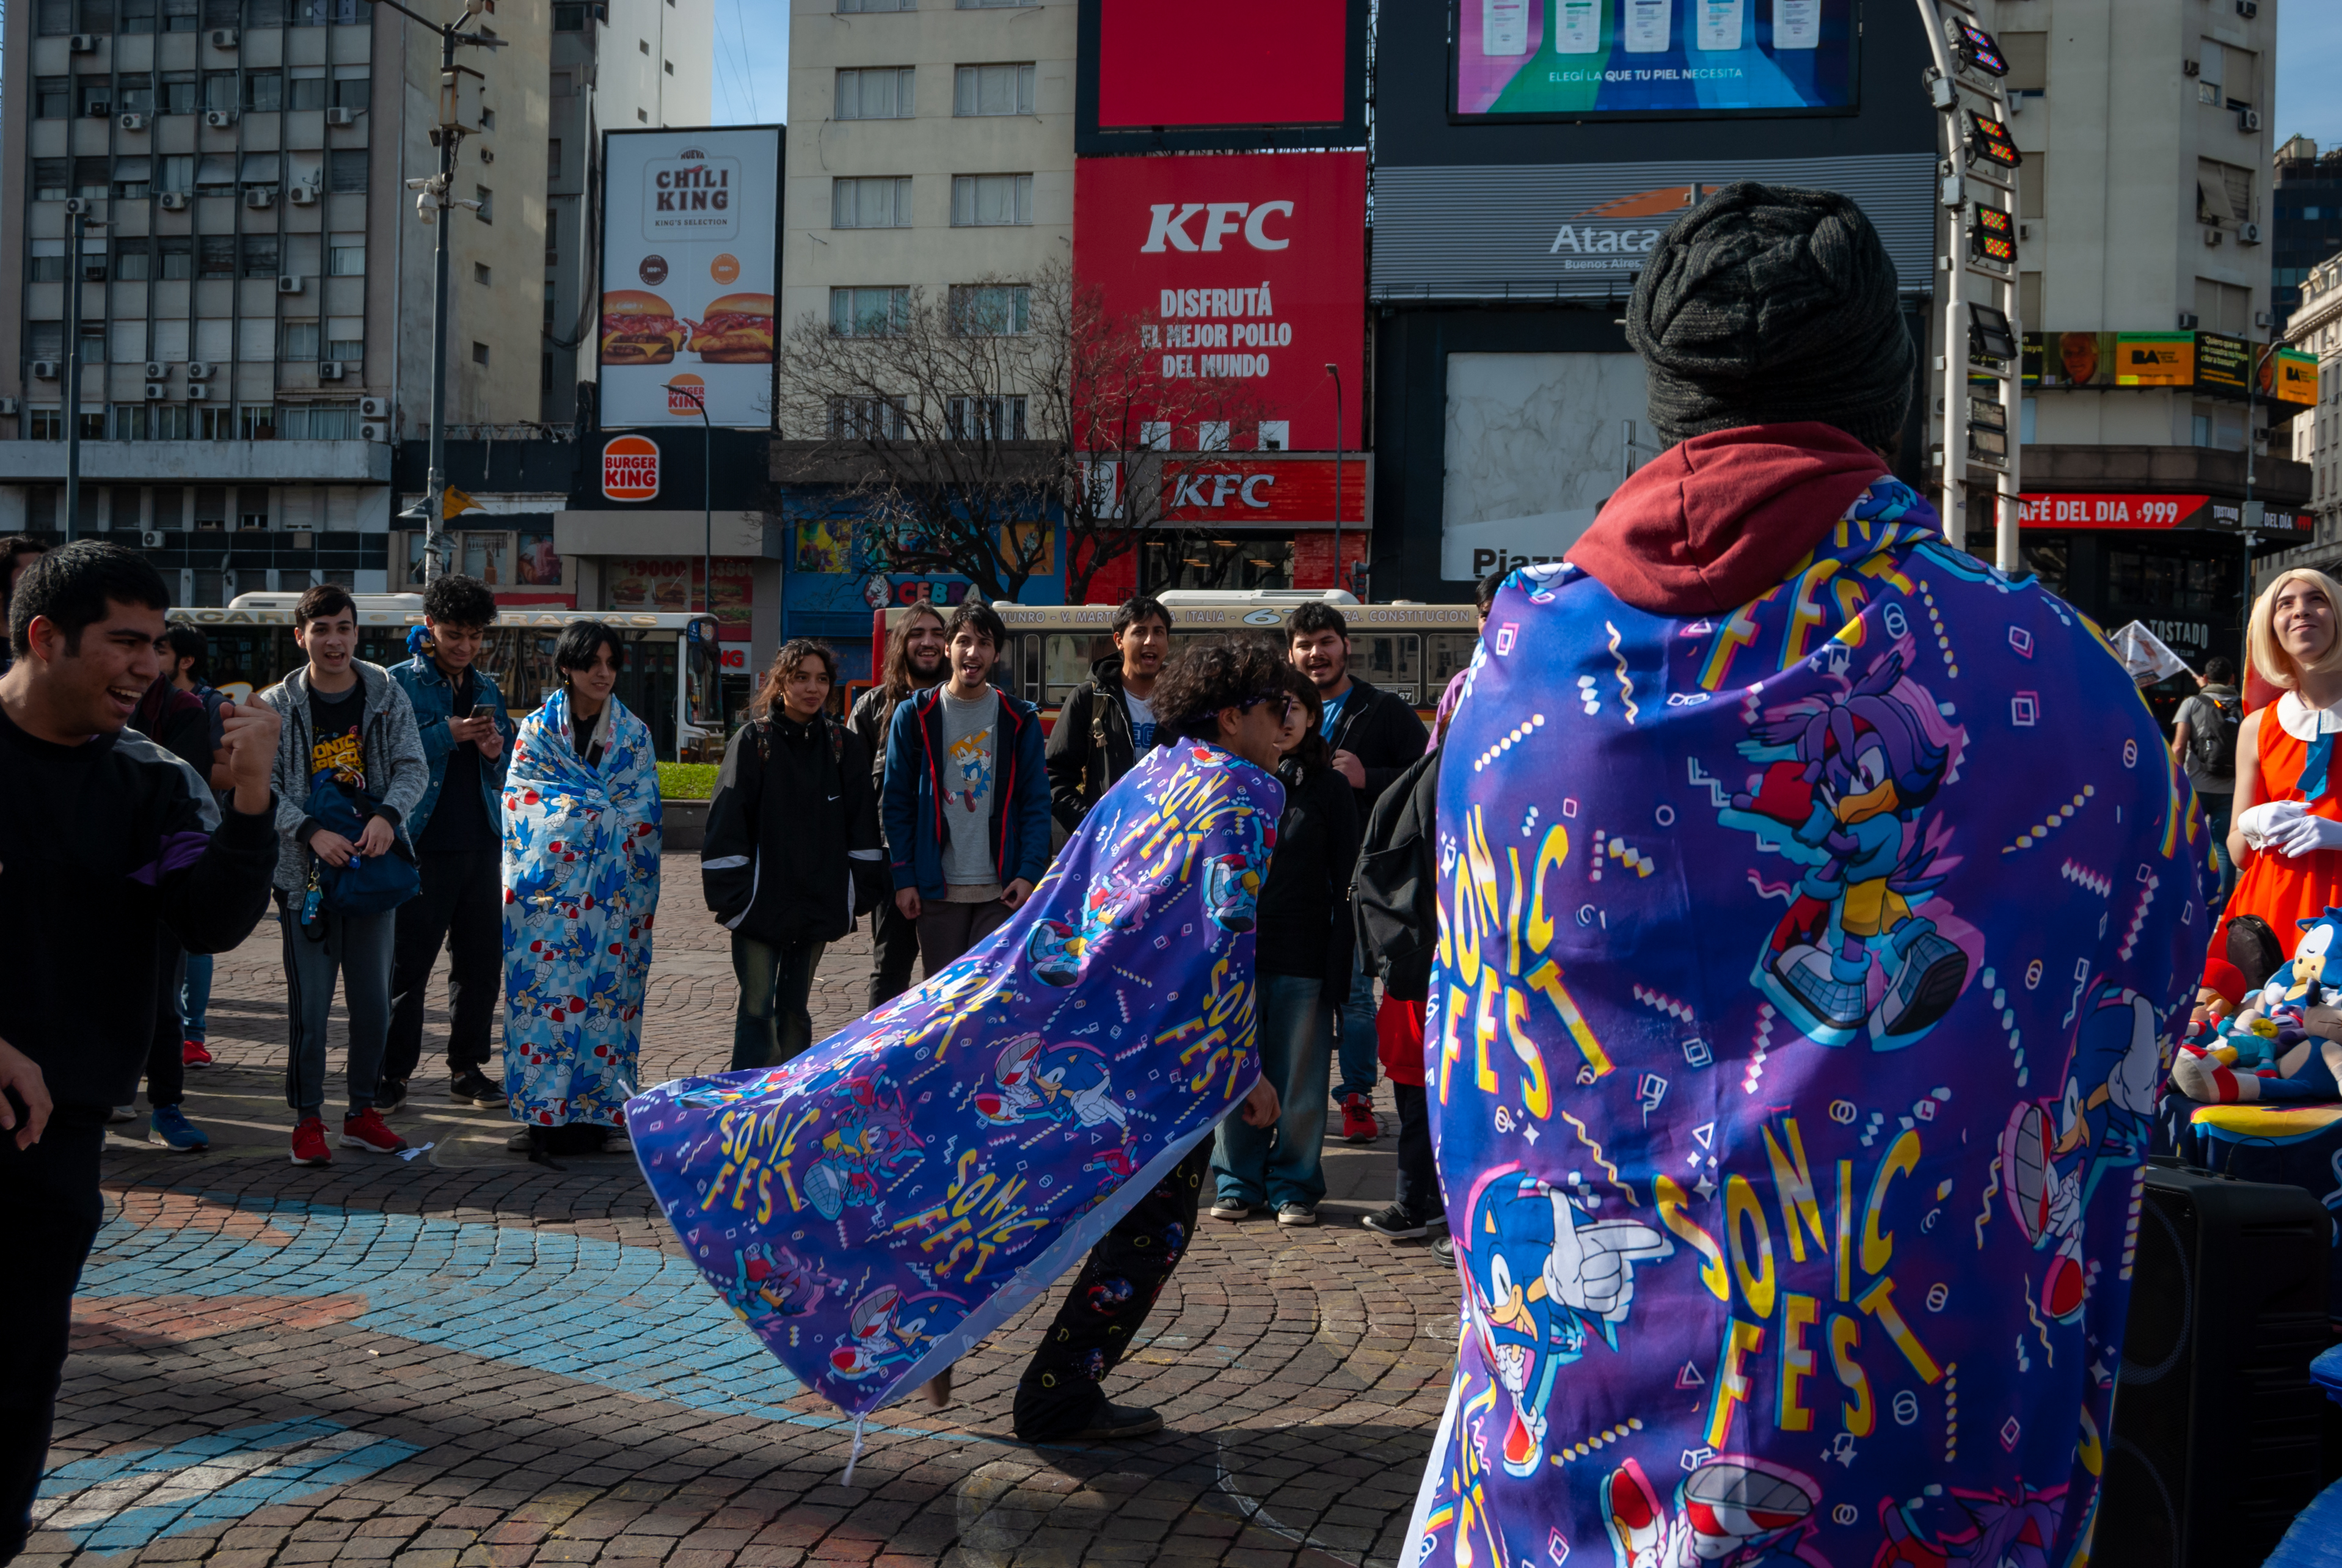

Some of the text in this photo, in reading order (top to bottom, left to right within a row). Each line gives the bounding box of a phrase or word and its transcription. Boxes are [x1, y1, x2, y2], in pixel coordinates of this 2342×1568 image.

[1549, 68, 1743, 82] ELEGÍ LA QUE TU PIEL NECESITA
[680, 150, 705, 159] NUEVA
[655, 169, 729, 189] CHILI
[656, 189, 729, 211] KING
[1140, 200, 1294, 253] KFC
[1564, 260, 1608, 270] Buenos
[1161, 281, 1272, 317] DISFRUTÁ
[1141, 323, 1292, 348] EL MEJOR POLLO
[1162, 354, 1269, 378] DEL MUNDO
[2132, 349, 2160, 365] BA
[668, 386, 704, 395] BURGER
[668, 395, 704, 408] KING
[605, 456, 657, 469] BURGER
[604, 469, 657, 487] KING
[1171, 473, 1274, 508] KFC
[2056, 501, 2090, 522] DEL
[2096, 501, 2129, 522] DIA
[2136, 501, 2178, 523] $999
[2264, 512, 2278, 528] DEL
[2278, 511, 2293, 530] DÍA
[898, 581, 982, 604] CEBRA
[1000, 611, 1046, 623] MUNRO
[1061, 611, 1071, 622] V.
[1186, 611, 1225, 622] ITALIA
[1369, 610, 1470, 622] CONSTITUCION
[2149, 619, 2208, 649] TOSTADO
[313, 734, 357, 759] ONIC
[313, 748, 360, 771] PEED
[1159, 762, 1253, 831] SONIC
[1120, 810, 1203, 883] FEST
[1440, 956, 1616, 1120] FEST
[1155, 1015, 1247, 1099] FEST
[720, 1101, 821, 1165] SONIC
[701, 1156, 802, 1225] FEST
[947, 1148, 1050, 1243] SONIC
[1652, 1117, 1922, 1319] SONIC
[893, 1204, 996, 1284] FEST
[1706, 1277, 1944, 1450] FEST
